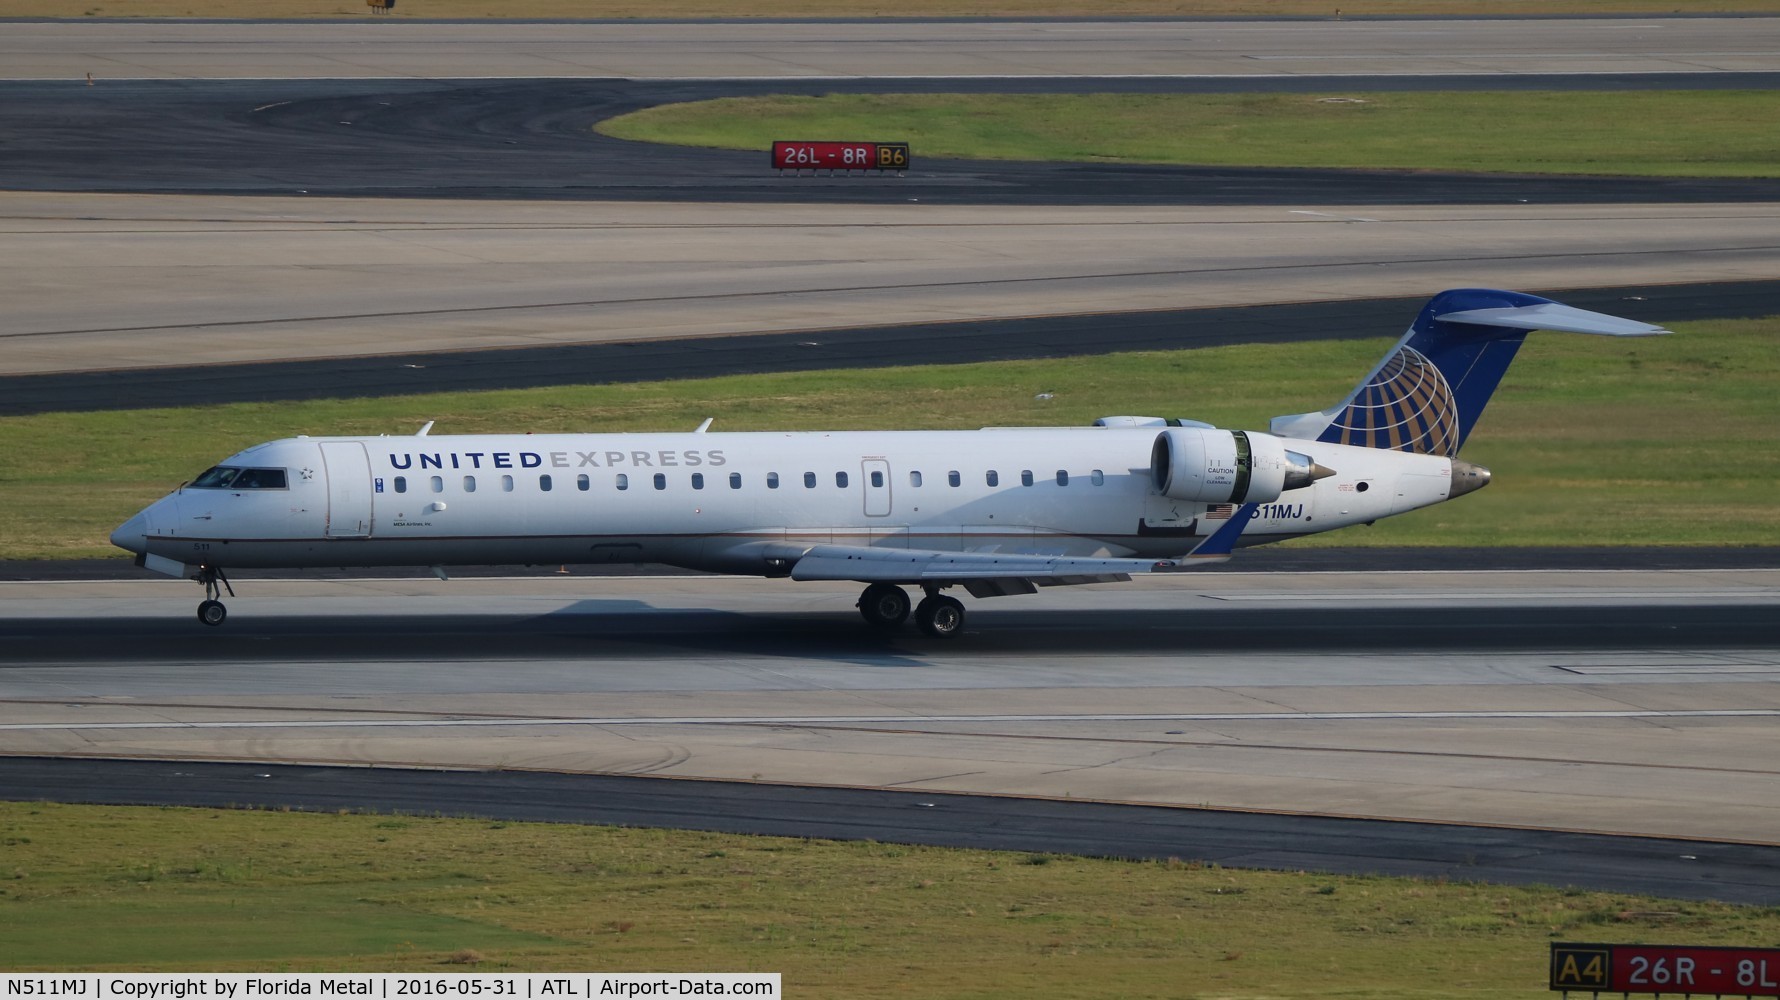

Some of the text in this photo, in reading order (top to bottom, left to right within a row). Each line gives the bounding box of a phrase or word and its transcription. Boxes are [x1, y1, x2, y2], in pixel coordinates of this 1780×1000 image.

[785, 148, 820, 164] 26L
[843, 148, 867, 164] 8R
[880, 149, 905, 164] B6
[389, 450, 727, 470] UNITED EXPRESS
[193, 542, 210, 551] 511
[1559, 954, 1603, 982] A4
[1629, 956, 1695, 985] 26R
[1736, 959, 1777, 987] 8L
